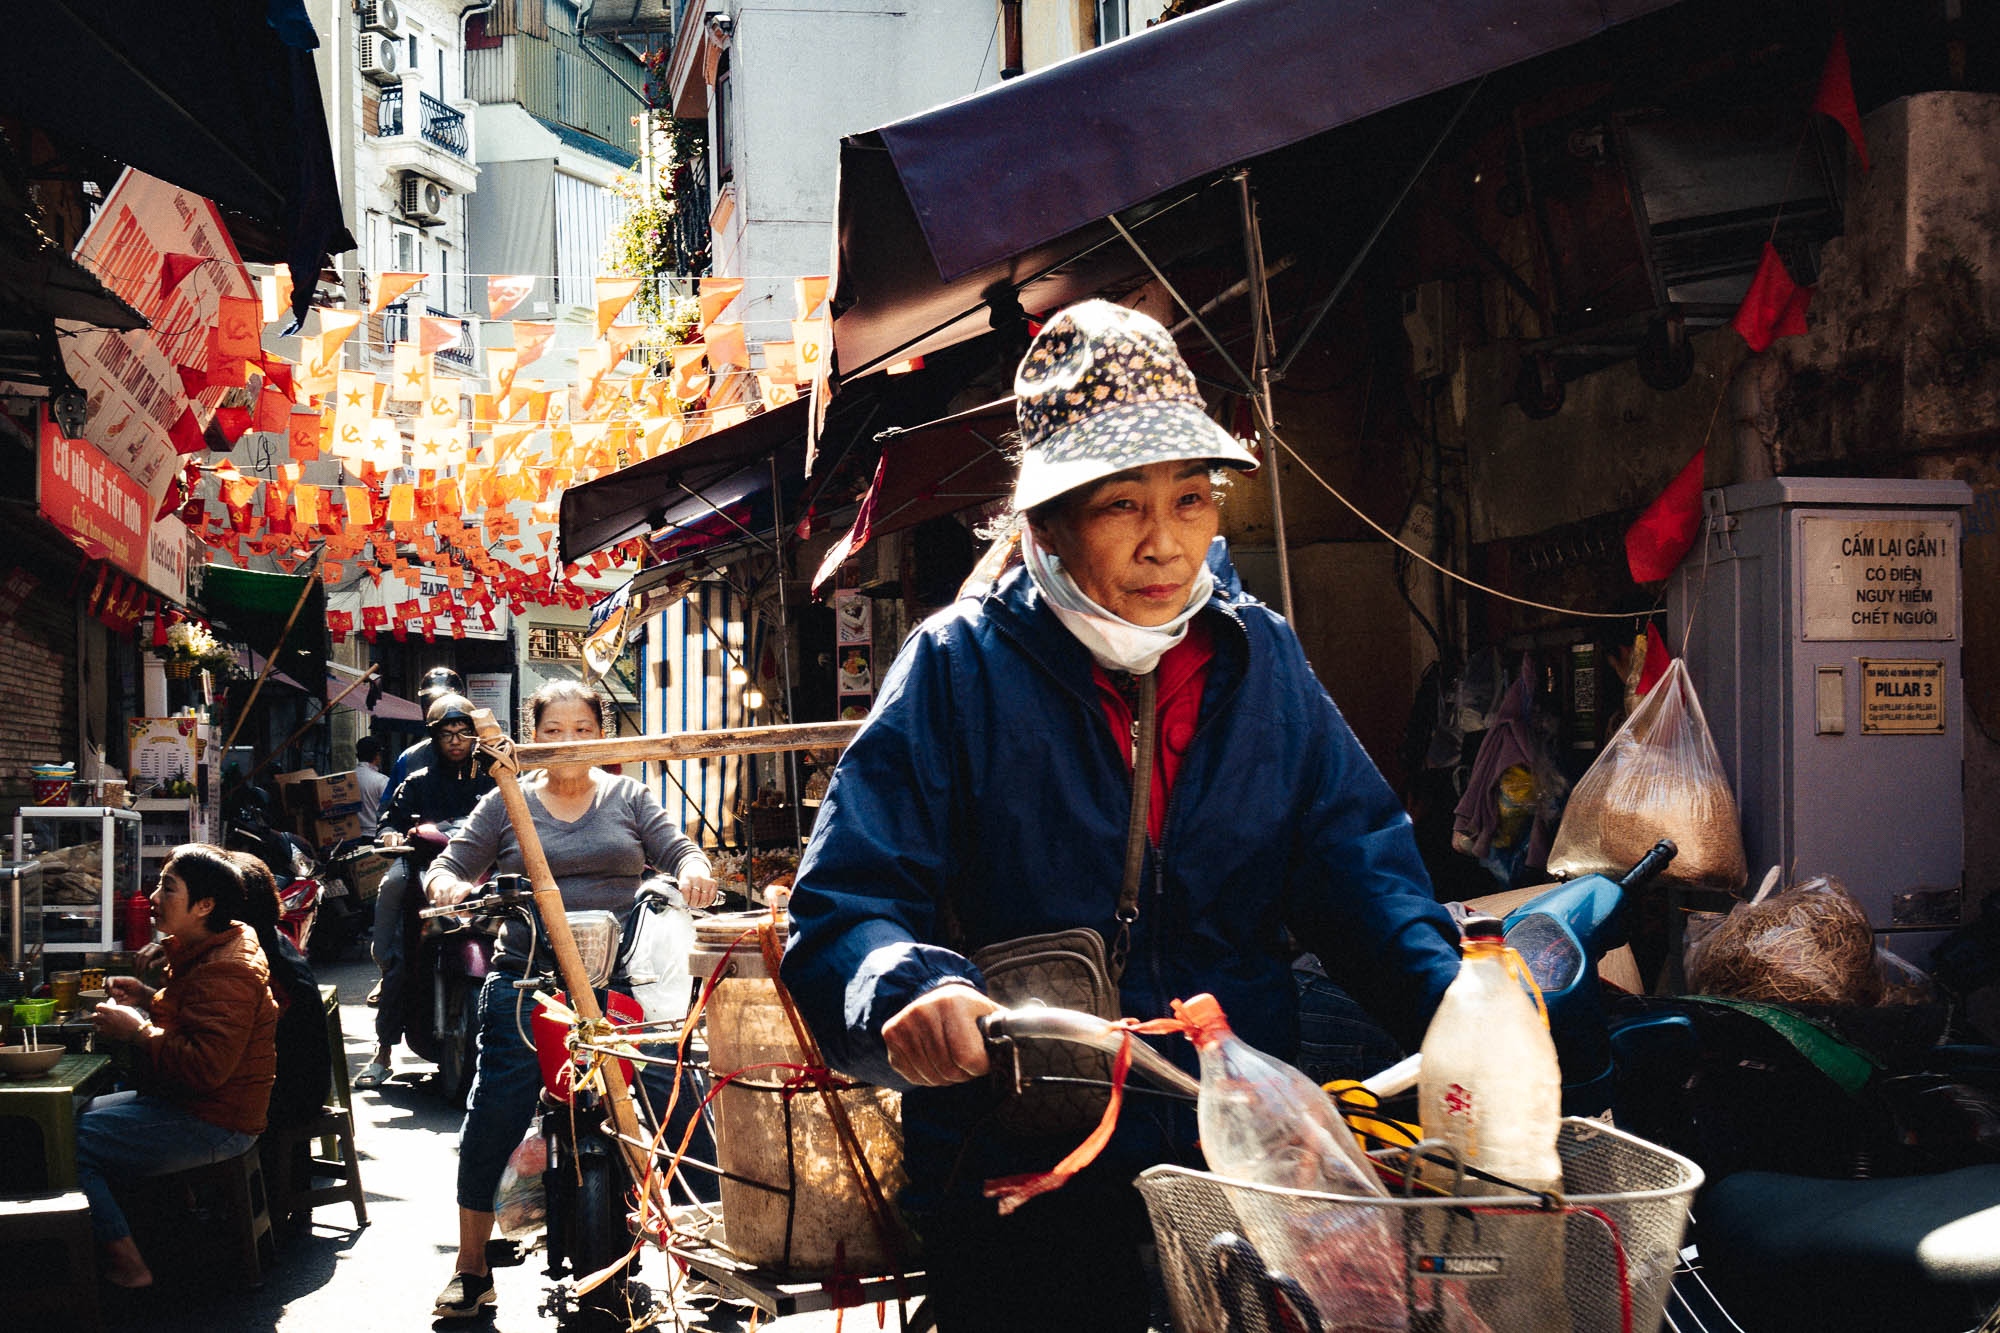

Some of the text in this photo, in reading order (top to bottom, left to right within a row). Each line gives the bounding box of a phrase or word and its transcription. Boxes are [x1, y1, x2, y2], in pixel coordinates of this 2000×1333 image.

[93, 204, 159, 305] TRUNG
[52, 435, 141, 537] CƠ HỘI ĐỂ TỐT HƠN
[1841, 531, 1874, 557] CẤM
[1878, 538, 1901, 561] LẠI
[1905, 531, 1937, 557] GẦN
[1865, 565, 1922, 585] CÓ ĐIỆN
[1856, 582, 1933, 602] NGUY HIỂM
[1851, 606, 1938, 625] CHẾT NGƯỜI
[1875, 682, 1932, 697] PILLAR 3
